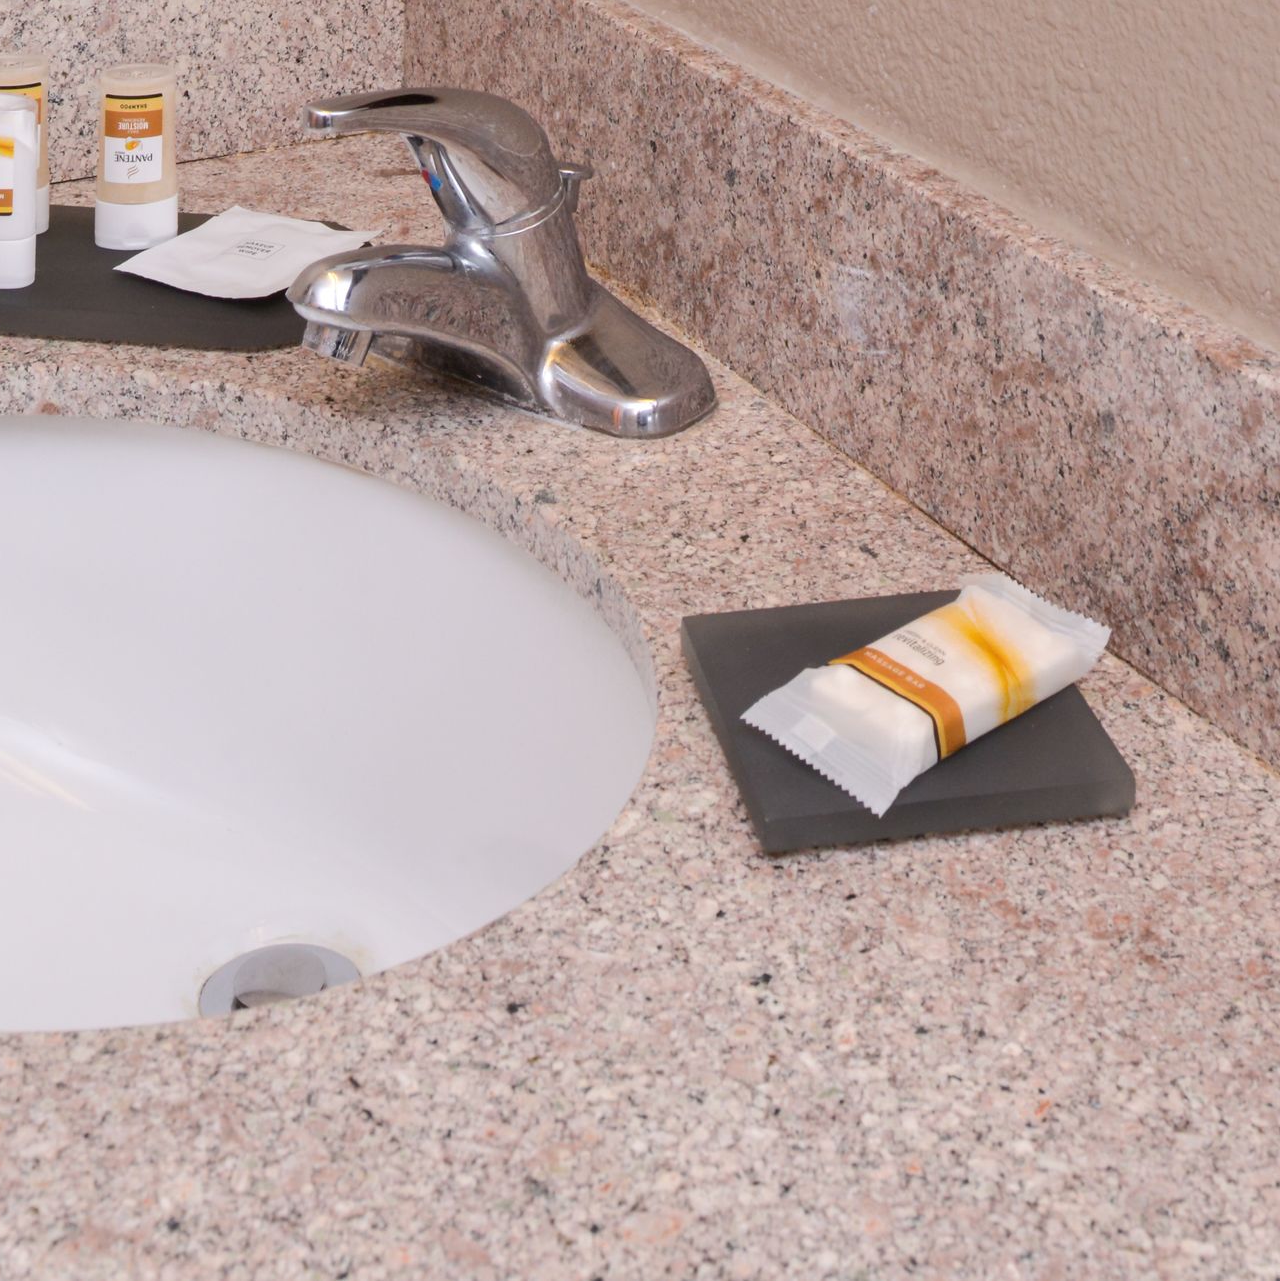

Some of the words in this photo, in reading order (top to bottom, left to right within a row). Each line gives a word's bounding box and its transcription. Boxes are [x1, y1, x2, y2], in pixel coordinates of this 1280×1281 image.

[118, 122, 149, 130] MOISTURE
[114, 153, 153, 163] PANTENE
[894, 632, 945, 666] revitalizing
[863, 650, 906, 676] MASSAGE
[905, 675, 926, 689] BAR
